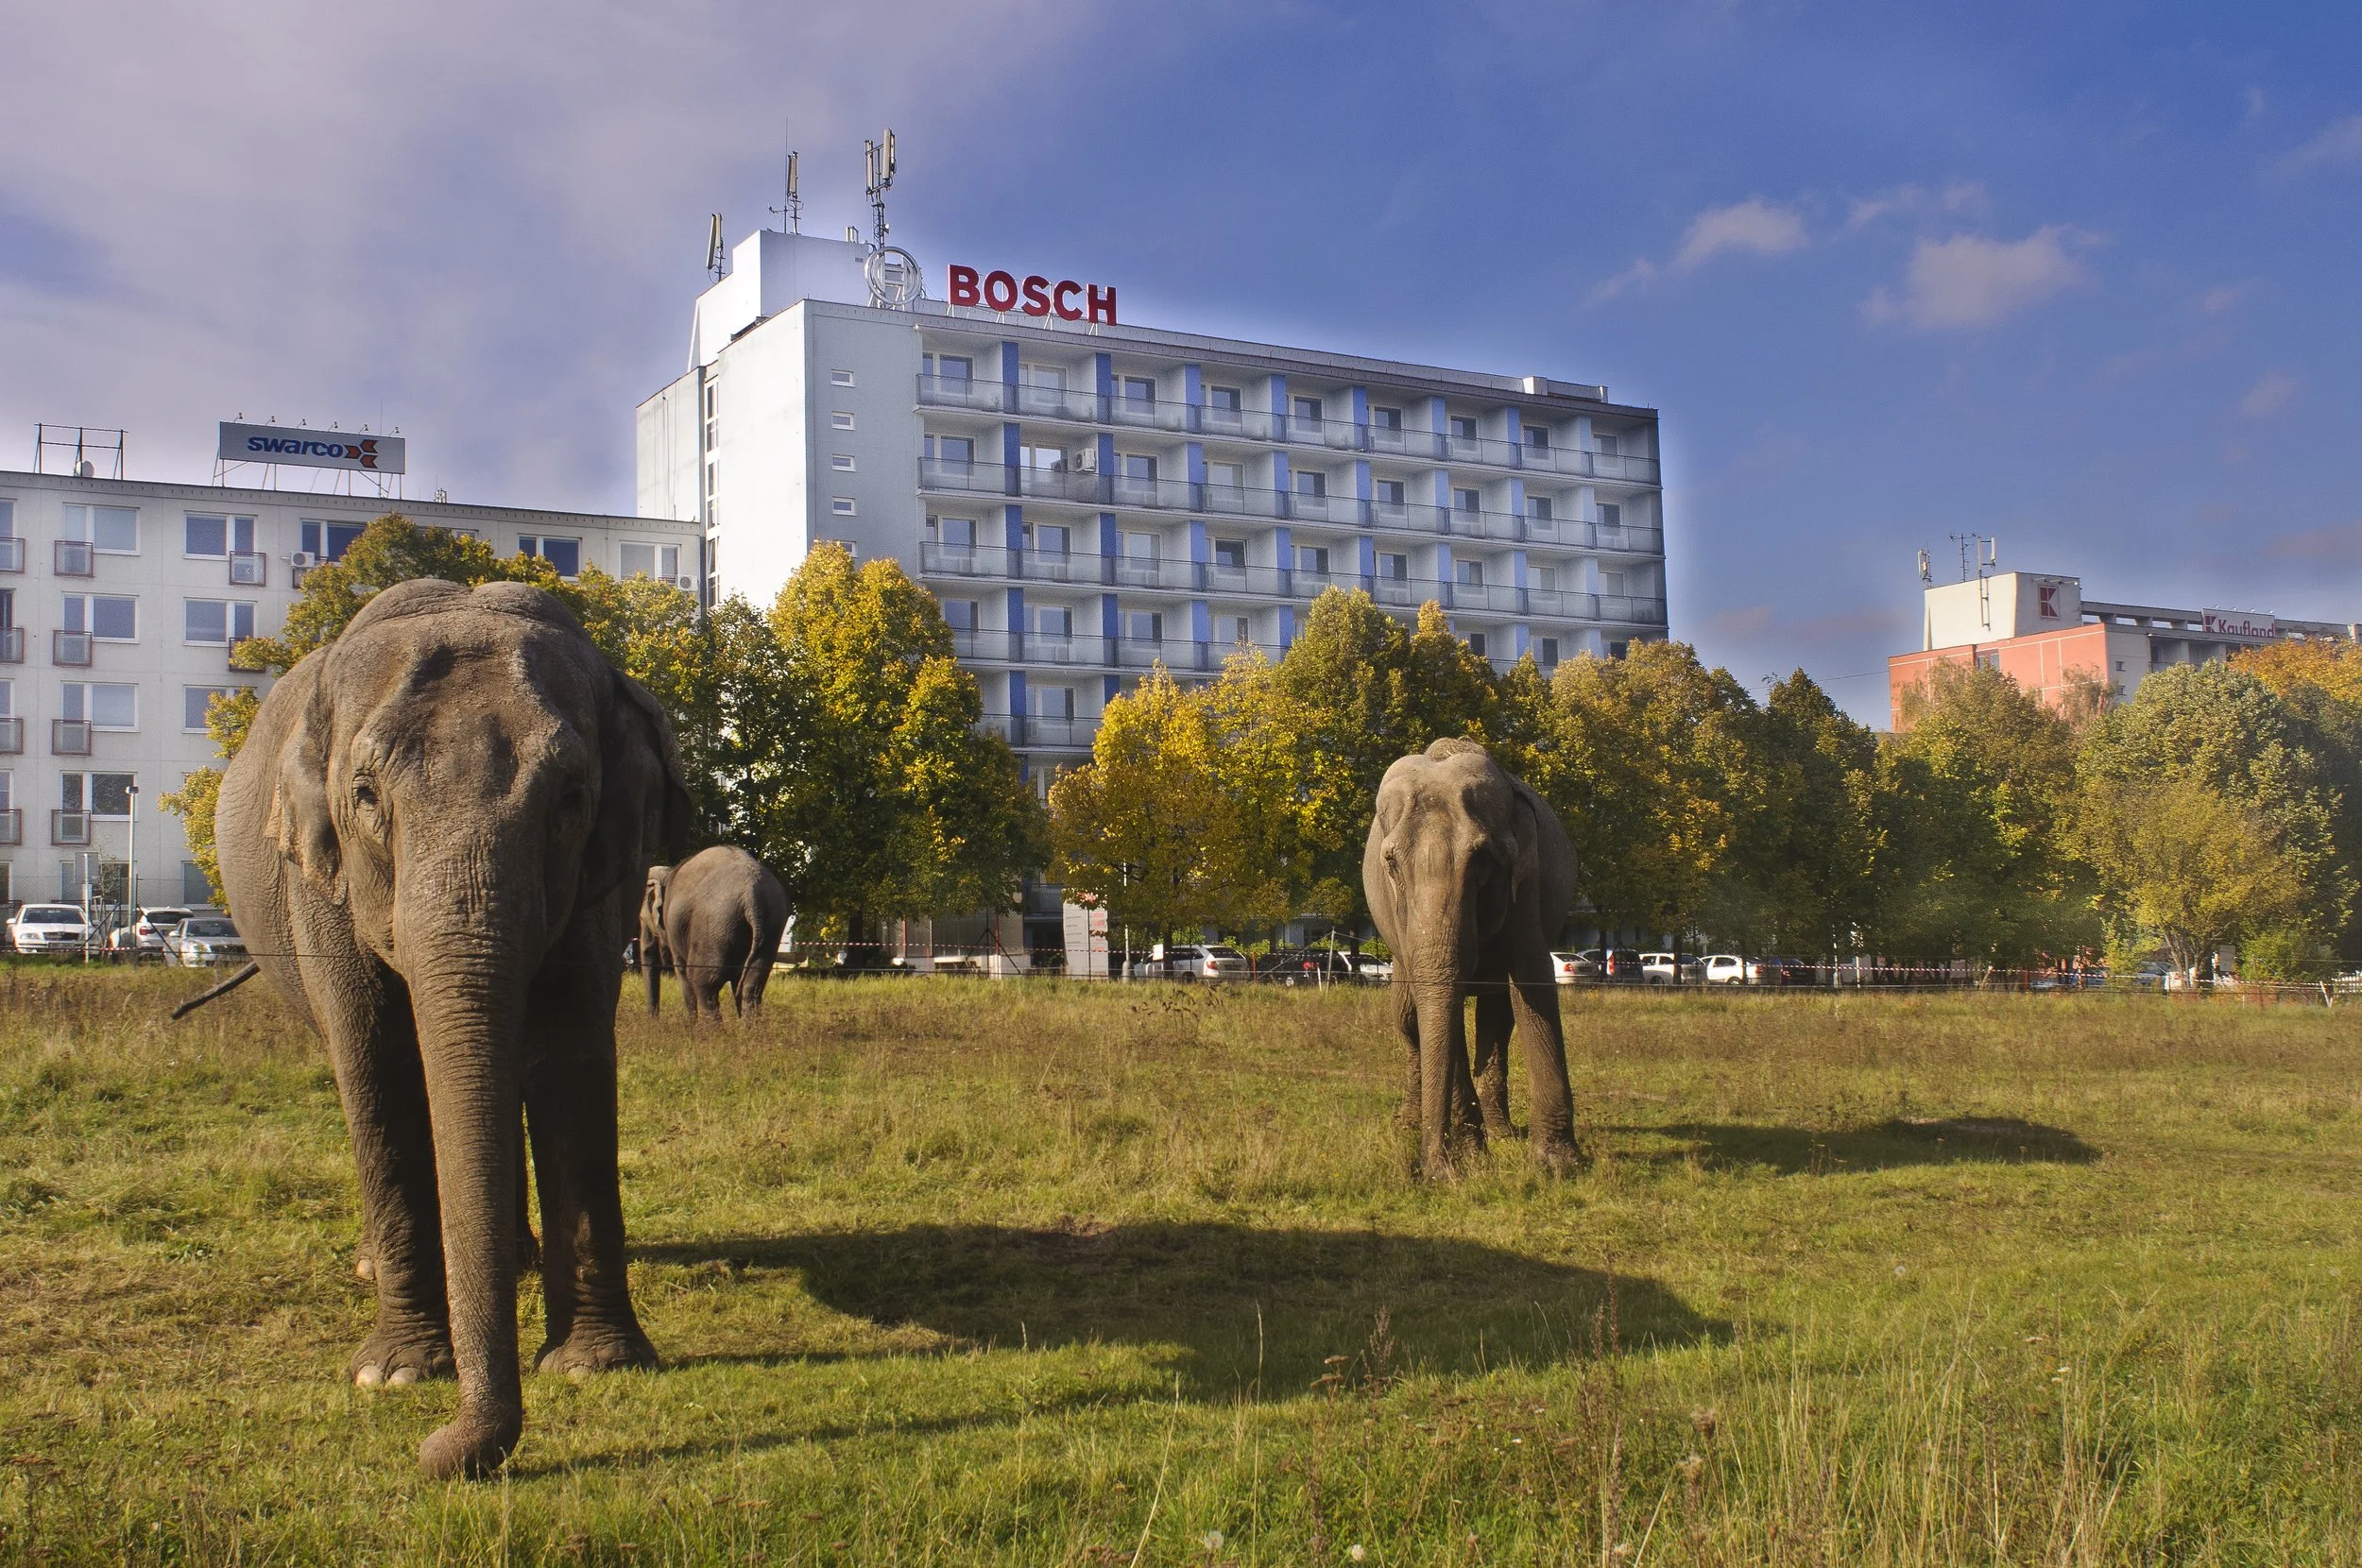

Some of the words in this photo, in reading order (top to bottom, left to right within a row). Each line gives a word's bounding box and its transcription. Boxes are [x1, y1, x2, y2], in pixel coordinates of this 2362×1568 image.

[948, 264, 1118, 327] BOSCH
[247, 435, 344, 458] swarco
[2218, 619, 2275, 638] Kaufland
